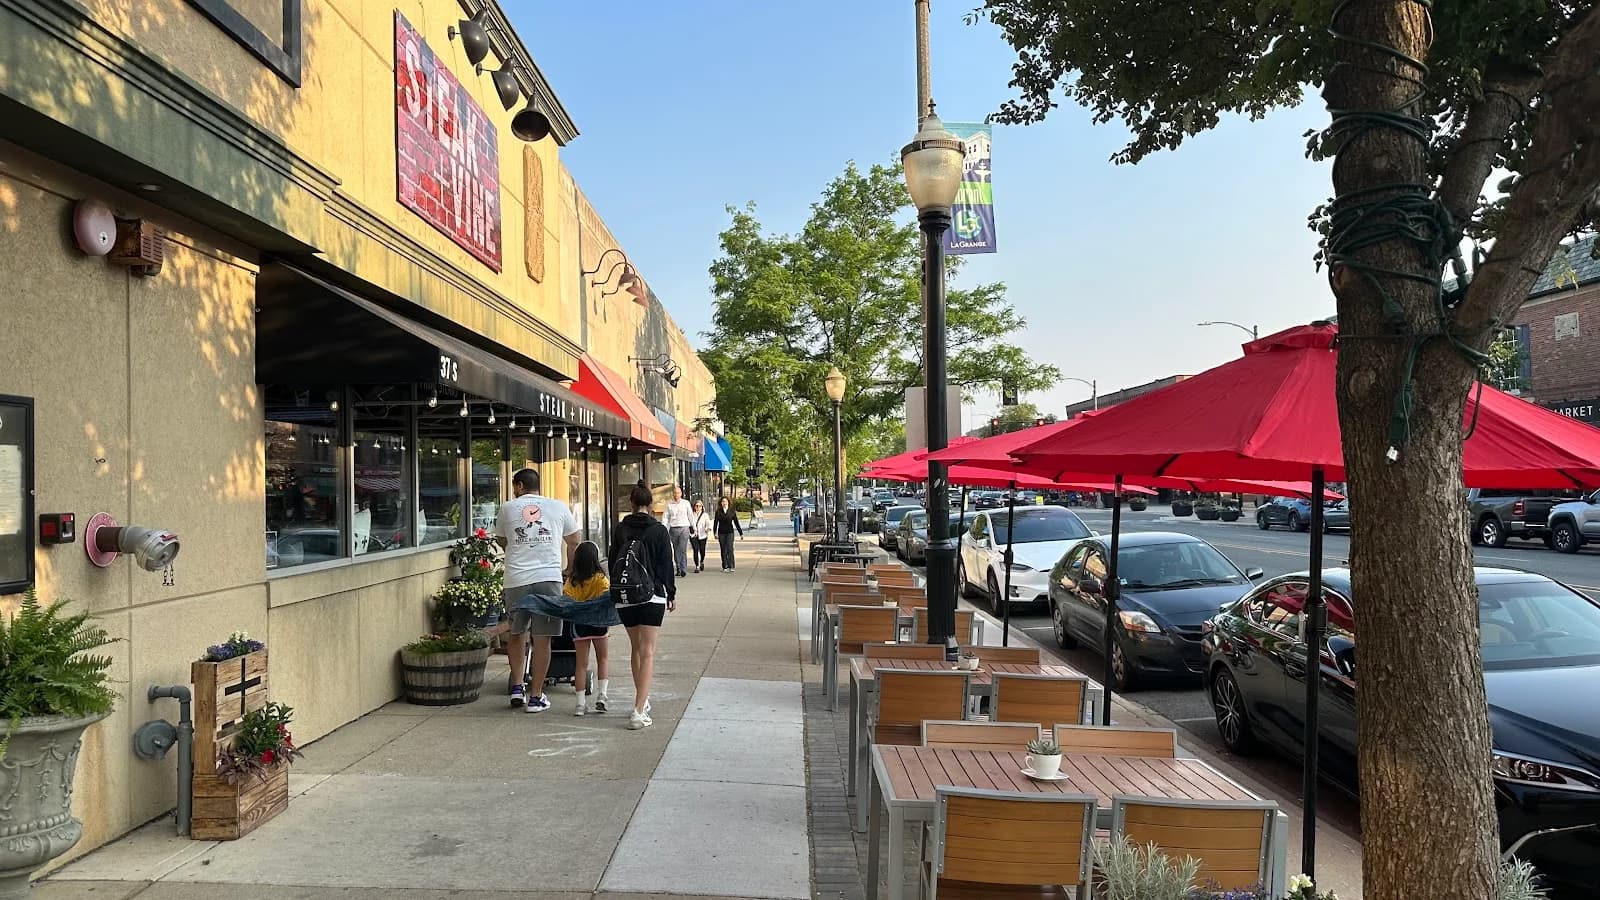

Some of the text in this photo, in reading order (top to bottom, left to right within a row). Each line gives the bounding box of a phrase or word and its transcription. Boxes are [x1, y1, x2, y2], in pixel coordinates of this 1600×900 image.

[405, 38, 479, 179] STEAK
[450, 159, 497, 254] VINE
[440, 355, 459, 382] 37 S
[540, 392, 566, 419] STEAK
[579, 406, 594, 428] VINE
[1554, 405, 1593, 417] ARKET
